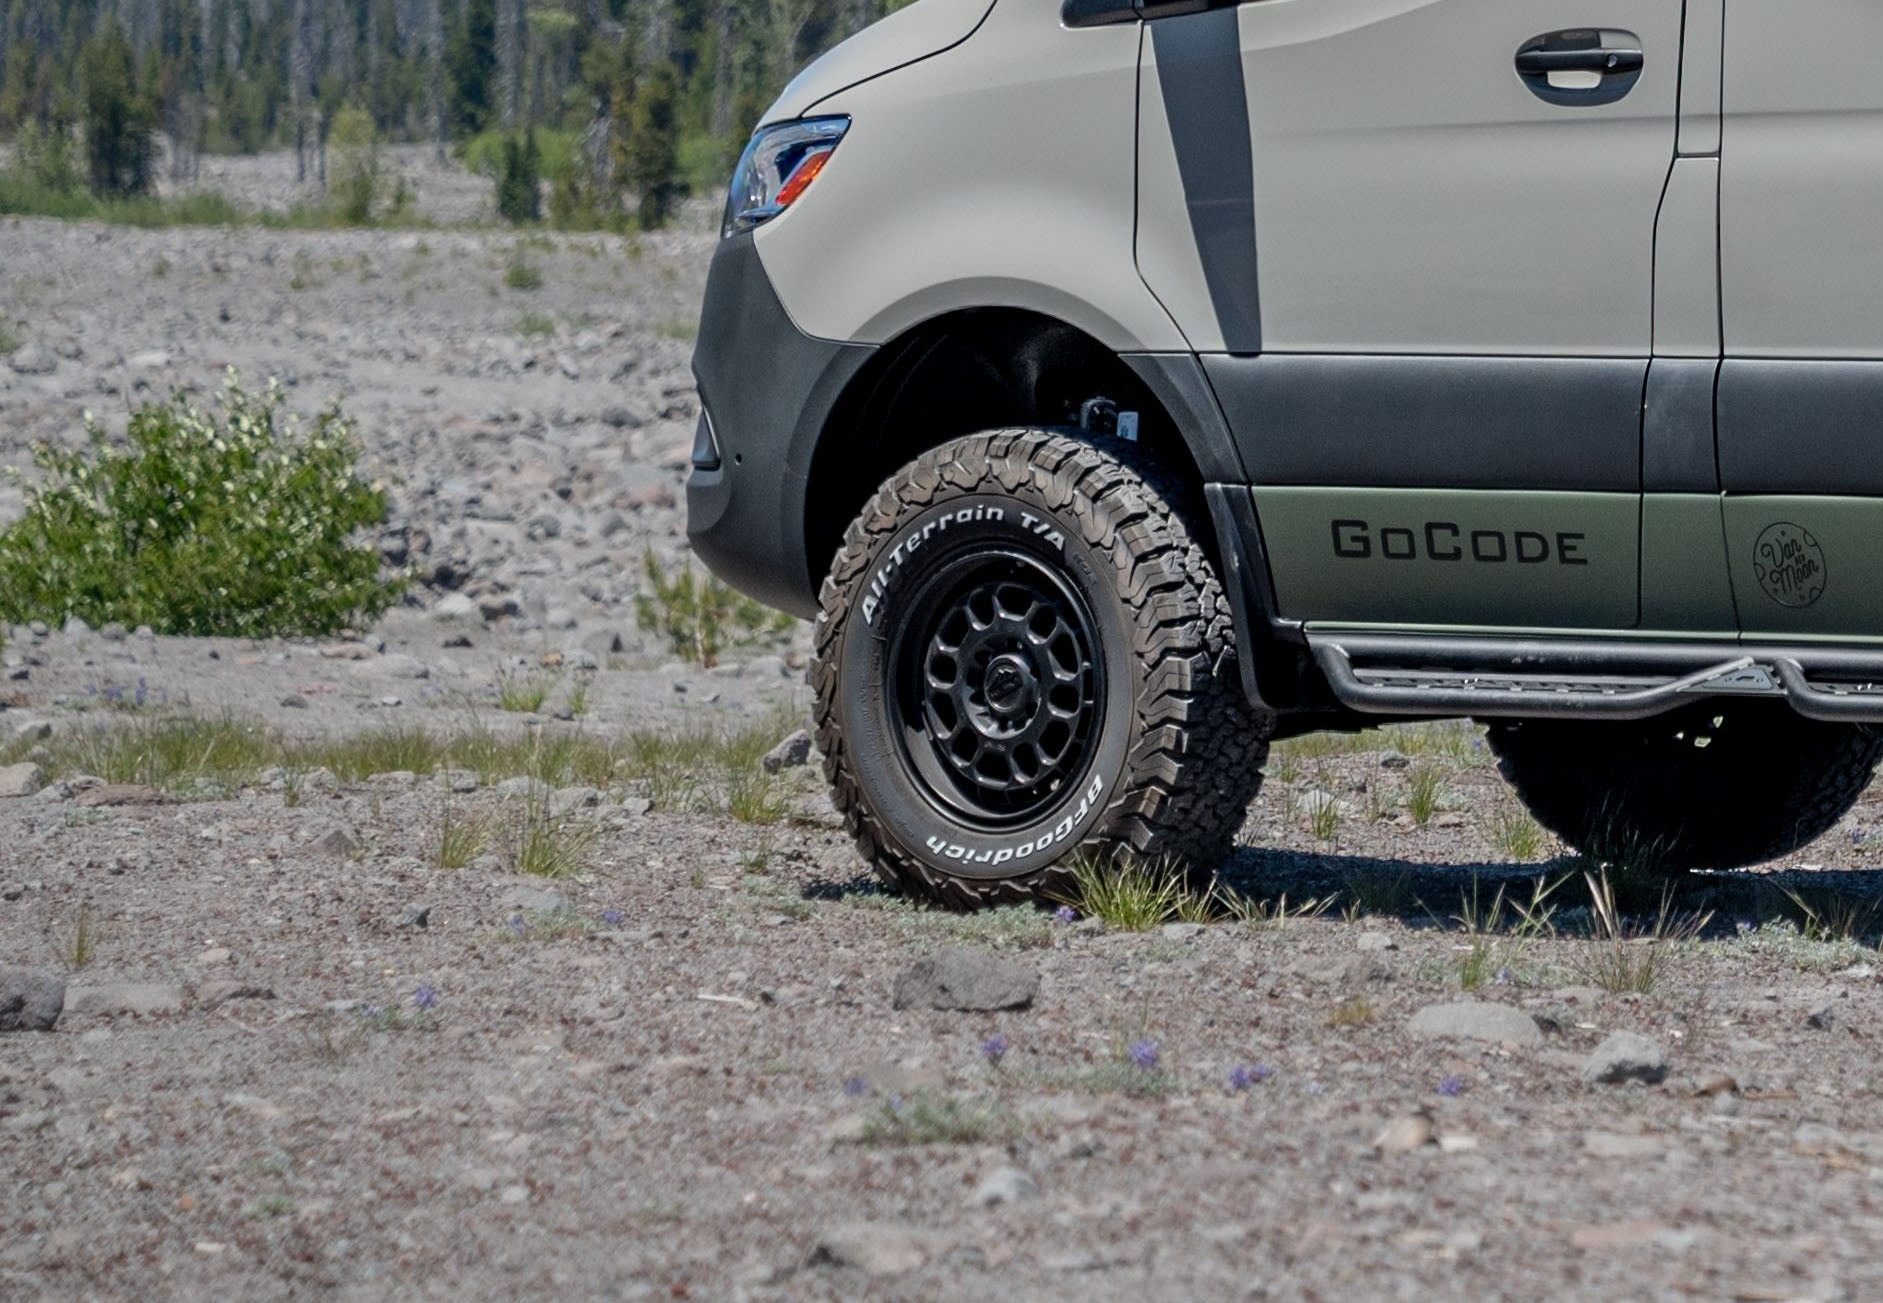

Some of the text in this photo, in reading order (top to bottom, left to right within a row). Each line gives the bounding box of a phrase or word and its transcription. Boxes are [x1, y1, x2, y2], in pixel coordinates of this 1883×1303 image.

[861, 504, 1004, 626] All-Terrain
[1021, 511, 1066, 552] T/A
[1760, 538, 1802, 568] Van
[1769, 559, 1820, 595] Moon
[924, 773, 1105, 866] BFGoodrich
